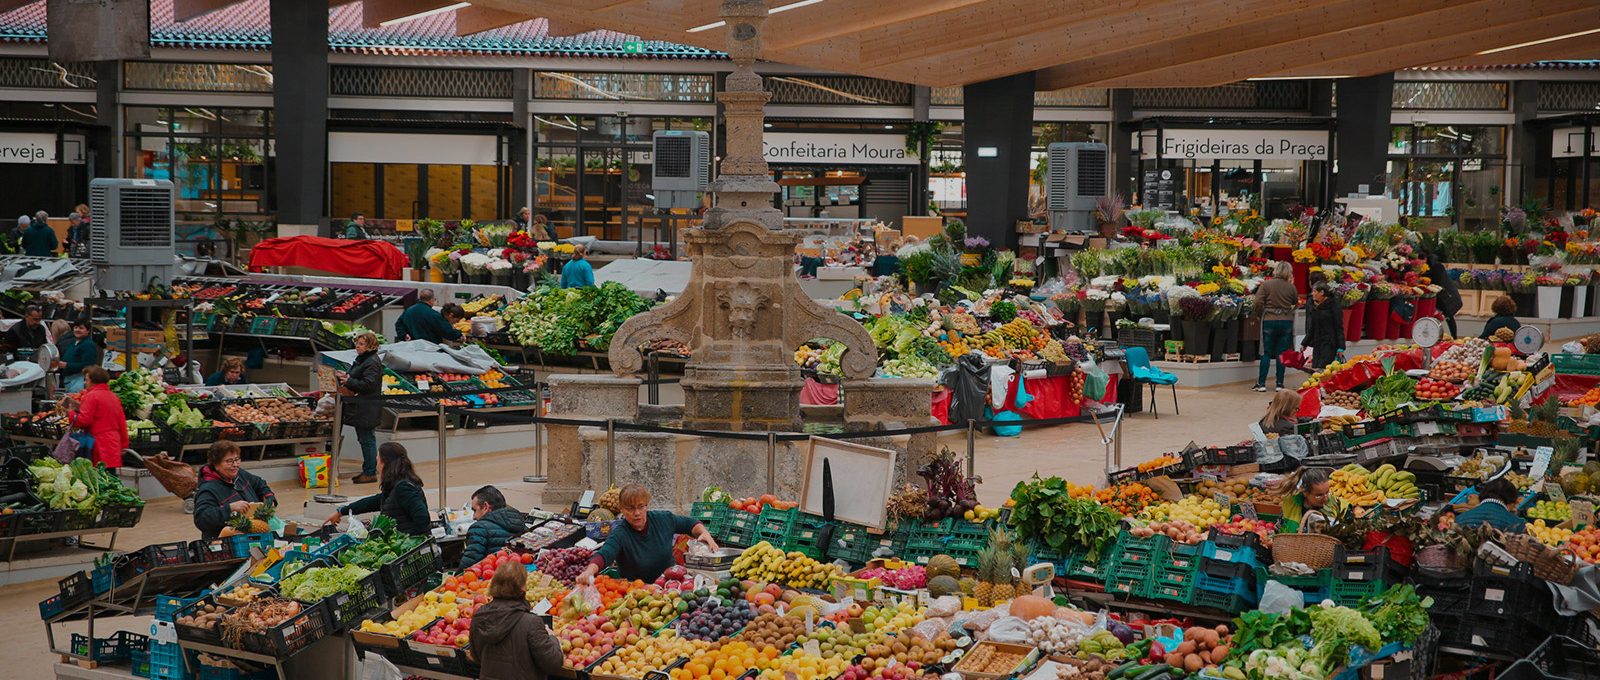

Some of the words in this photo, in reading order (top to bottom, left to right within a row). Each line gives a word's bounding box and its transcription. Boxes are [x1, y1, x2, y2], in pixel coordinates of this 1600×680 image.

[0, 143, 45, 163] rveja
[852, 143, 905, 159] Moura
[1164, 138, 1249, 159] Frigideiras
[1255, 138, 1274, 155] da
[1280, 139, 1326, 160] Praça
